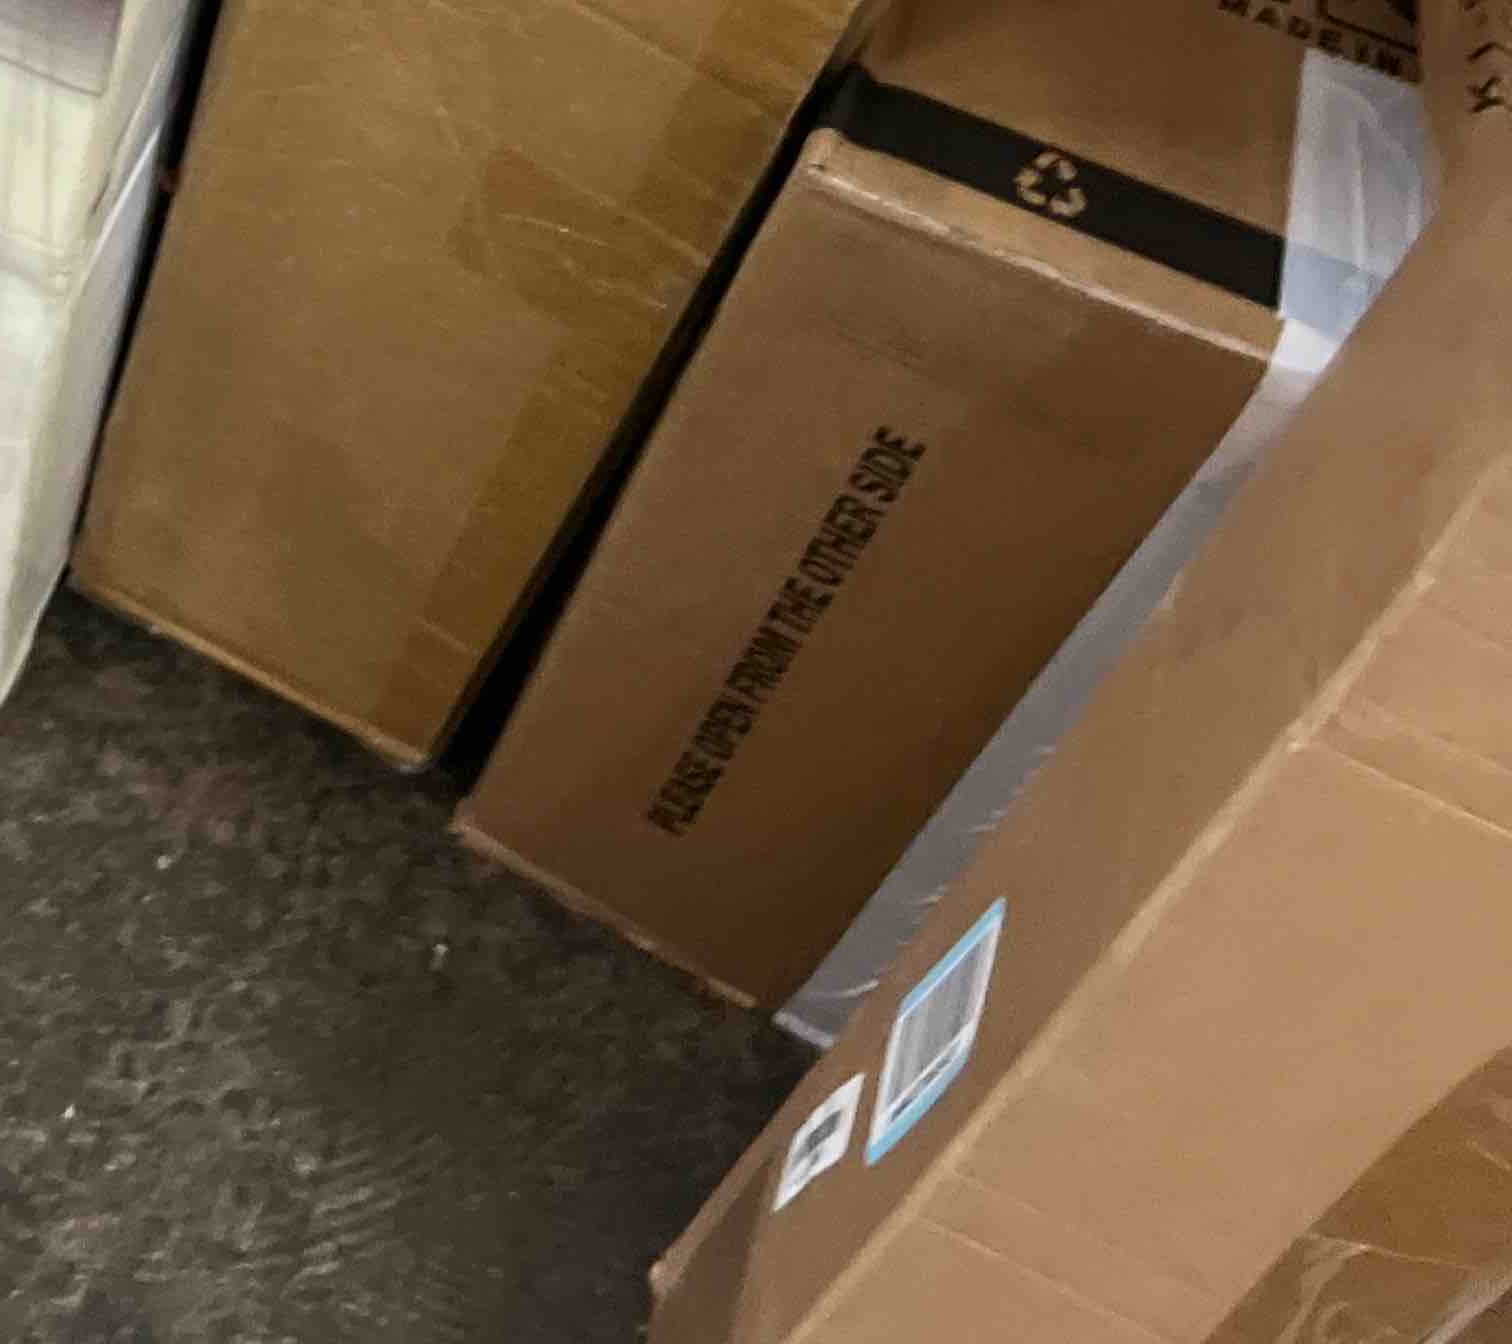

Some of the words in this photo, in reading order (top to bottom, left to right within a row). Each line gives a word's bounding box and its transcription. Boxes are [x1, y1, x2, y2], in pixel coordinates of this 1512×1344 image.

[848, 425, 928, 504] SIDE
[799, 493, 888, 588] OTHER
[768, 575, 835, 636] THE
[725, 625, 804, 706] FROM
[692, 696, 761, 762] OPEN
